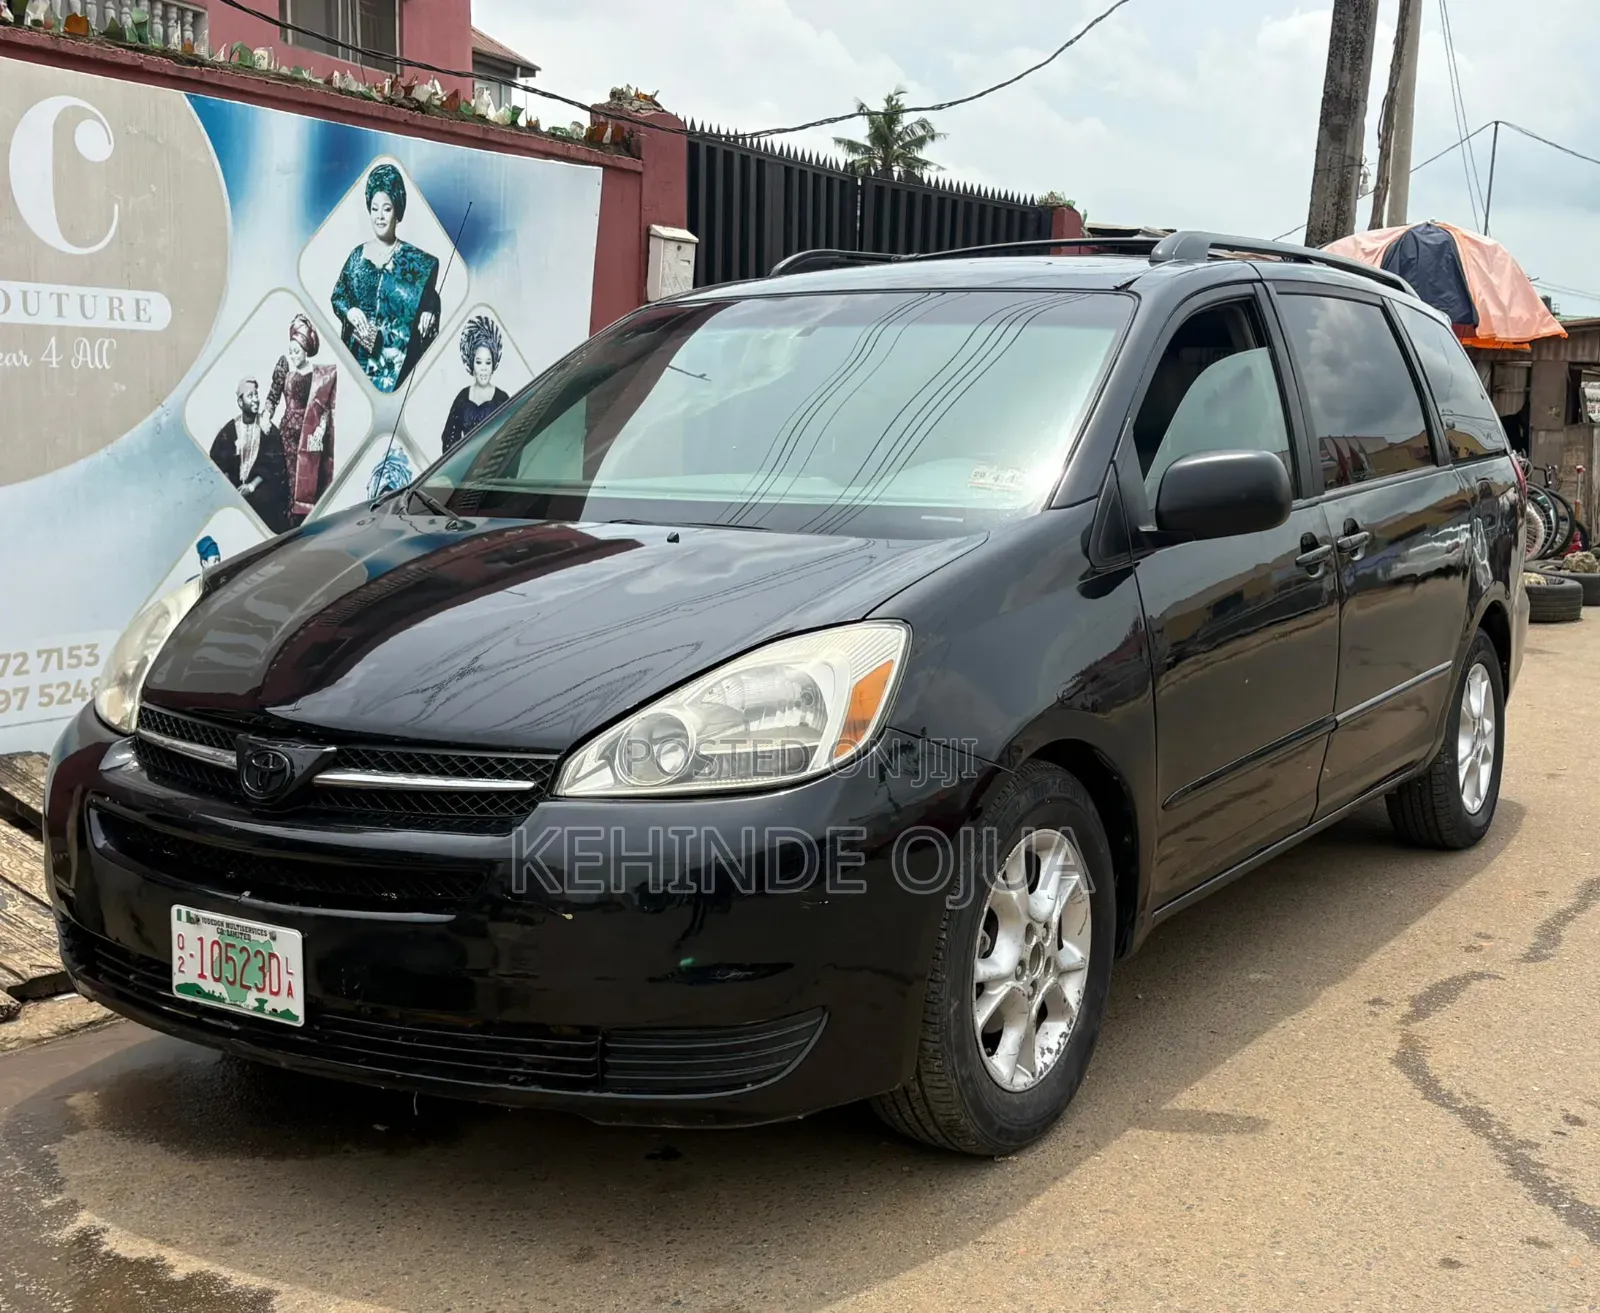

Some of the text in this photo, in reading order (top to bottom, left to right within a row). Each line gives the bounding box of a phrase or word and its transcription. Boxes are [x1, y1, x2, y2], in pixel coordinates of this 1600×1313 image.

[9, 95, 119, 255] C
[40, 335, 64, 368] 4
[71, 337, 117, 370] All
[37, 643, 100, 673] 7153
